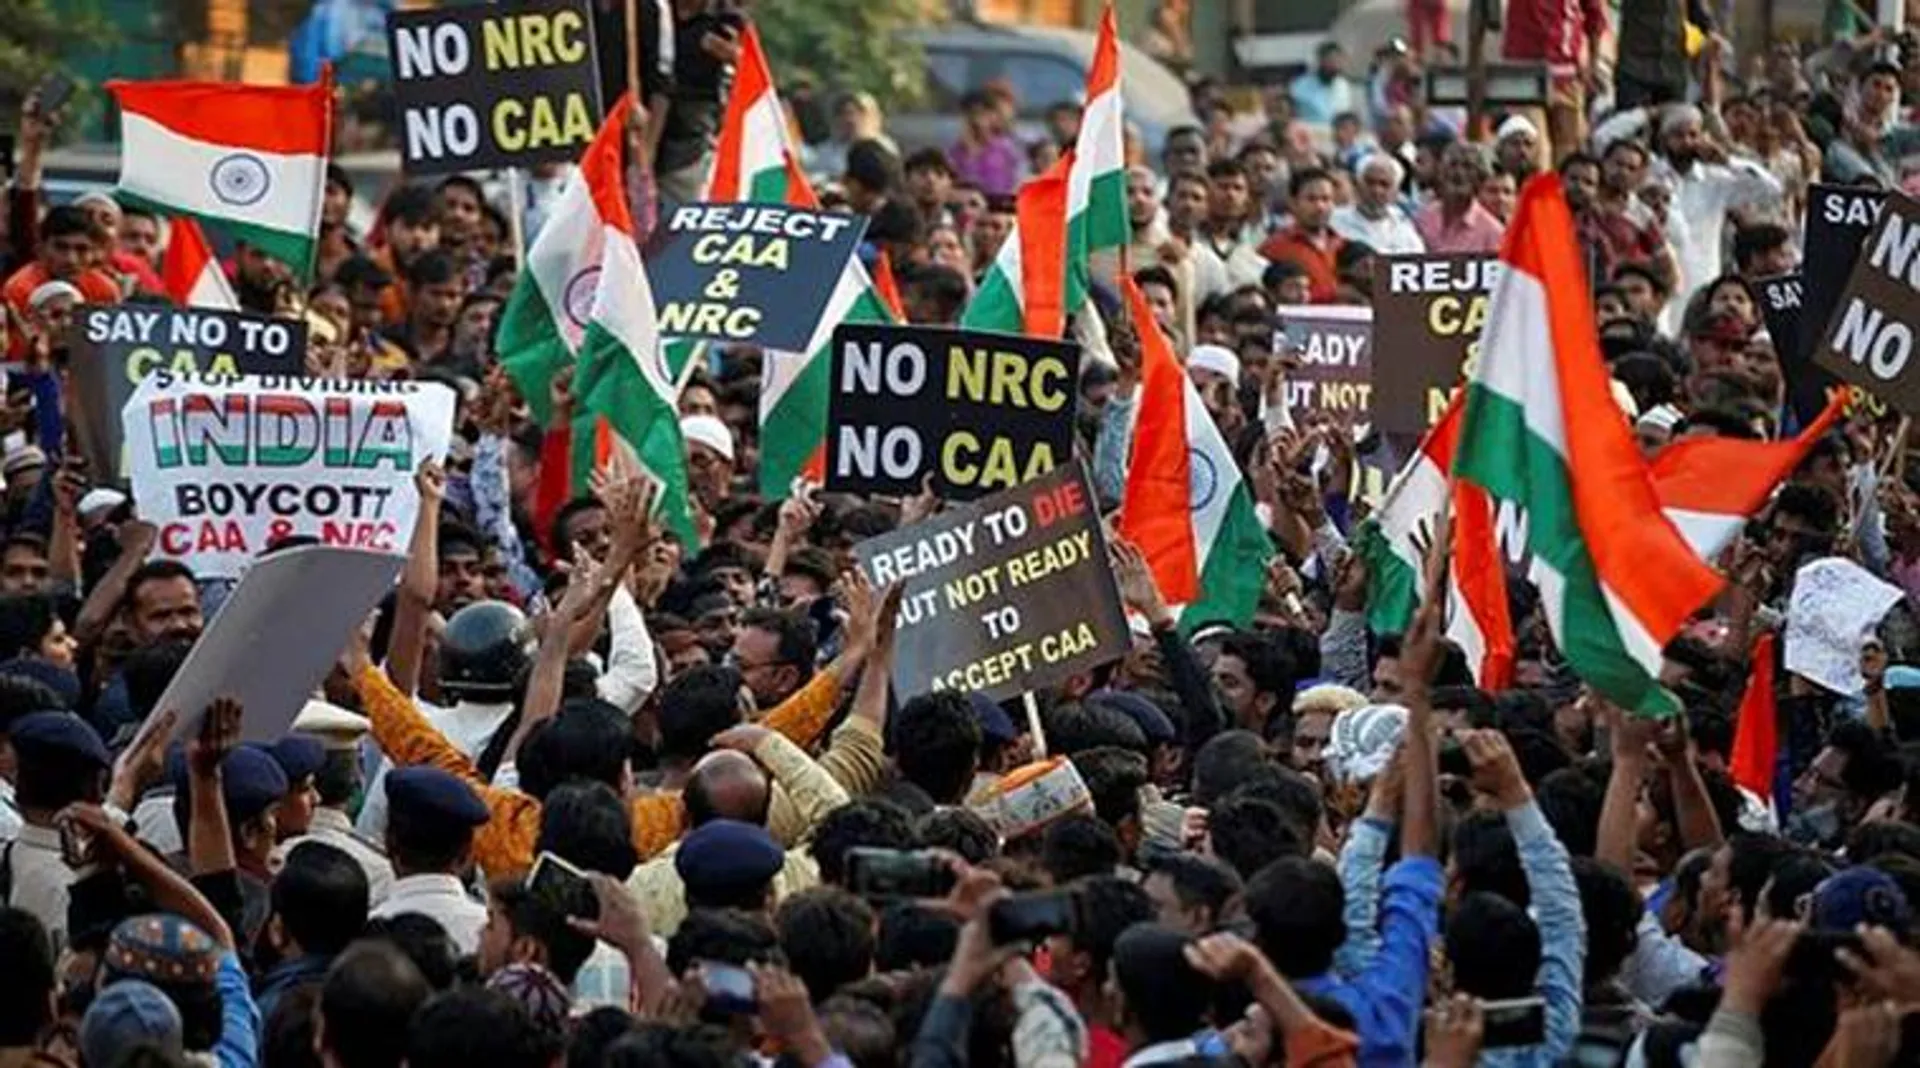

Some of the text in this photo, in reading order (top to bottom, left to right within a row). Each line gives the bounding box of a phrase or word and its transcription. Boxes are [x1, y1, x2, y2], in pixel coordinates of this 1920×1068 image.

[396, 10, 586, 79] NO NRC
[405, 92, 597, 160] NO CAA
[669, 206, 850, 242] REJECT
[1823, 194, 1886, 226] SAY
[692, 232, 789, 270] CAA
[704, 268, 741, 299] &
[87, 311, 290, 354] SAY NO TO
[656, 301, 763, 338] NRC
[1831, 296, 1913, 381] NO
[841, 340, 1069, 413] NO NRC
[1320, 382, 1372, 412] NOT
[149, 392, 414, 470] INDIA
[837, 425, 1055, 489] NO CAA
[175, 483, 393, 519] BOYCOTT
[160, 519, 397, 556] CAA & NRC
[871, 482, 1086, 586] READY TO DIE
[895, 530, 1091, 629] UT NOT READY
[981, 605, 1022, 640] TO
[1040, 621, 1098, 664] CAA
